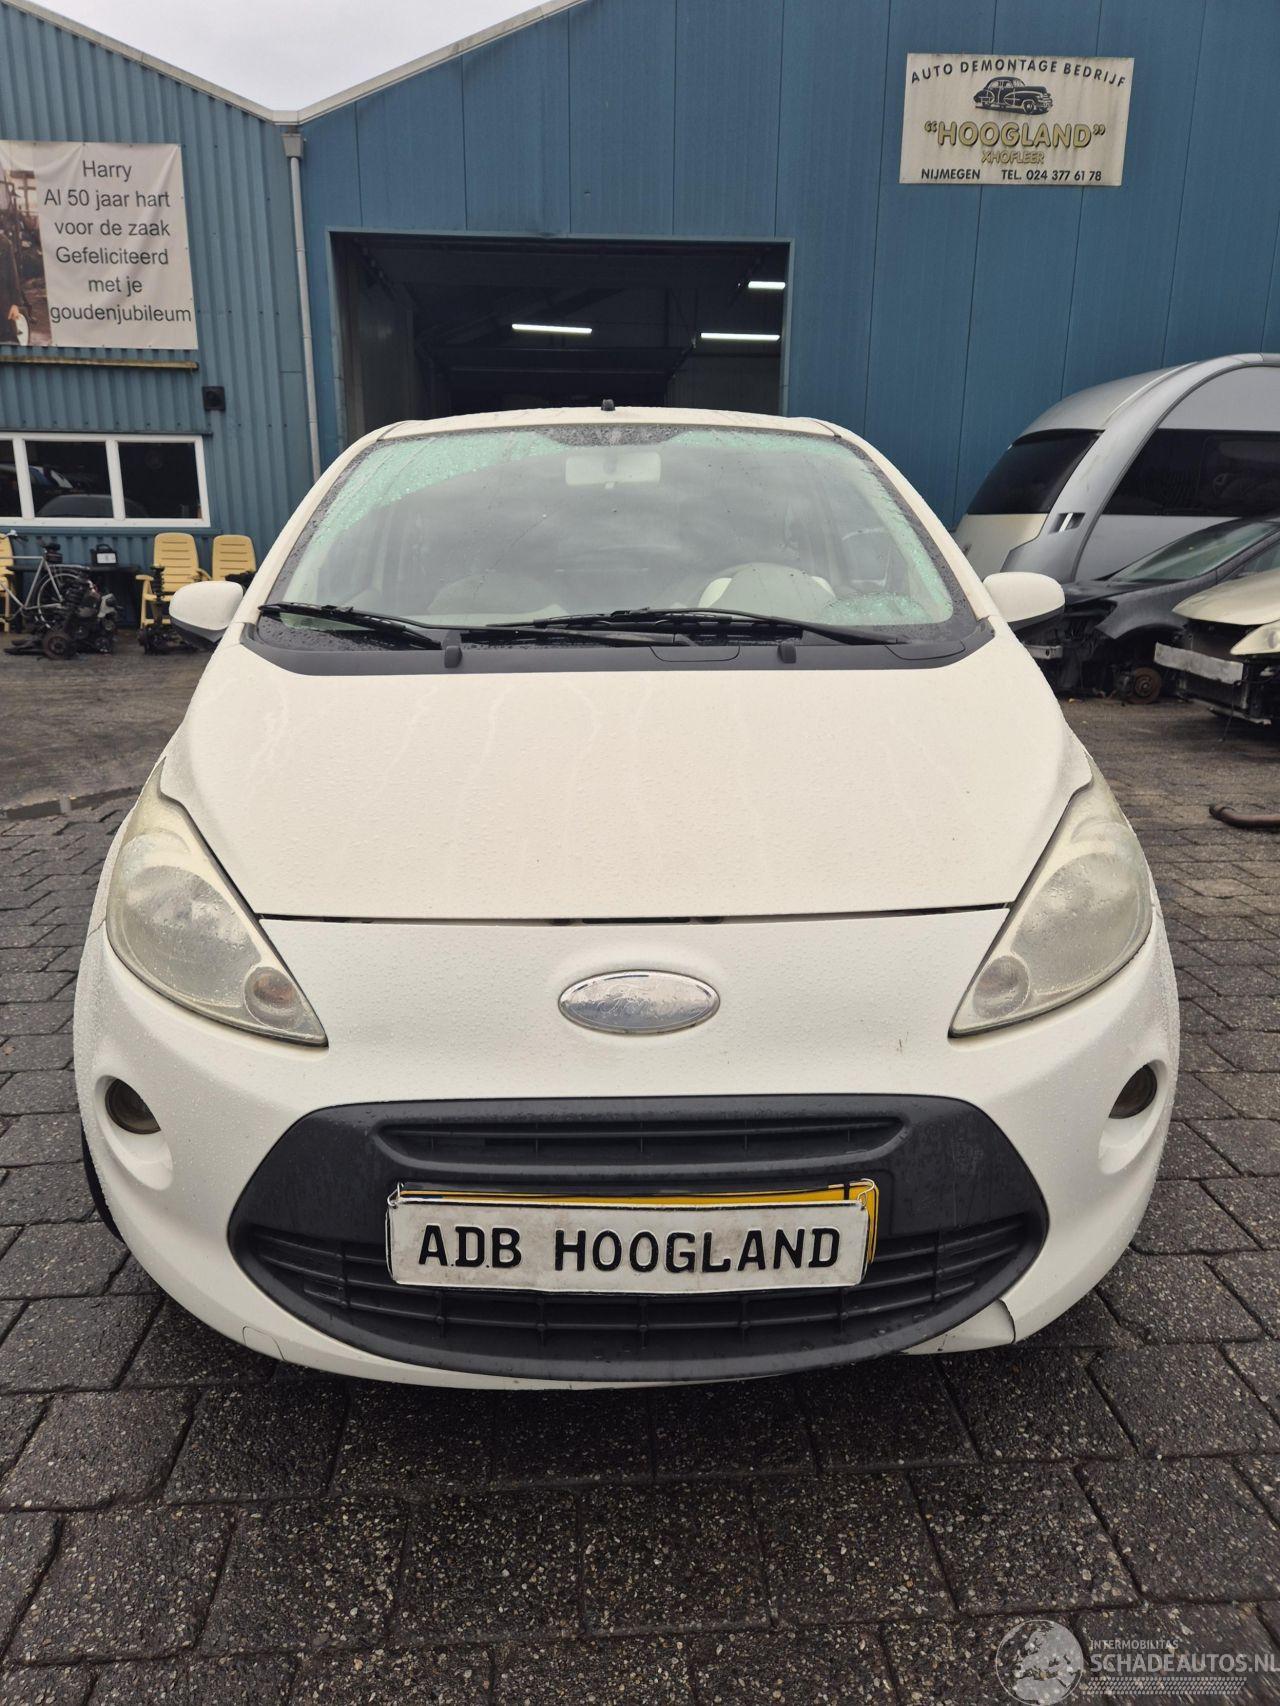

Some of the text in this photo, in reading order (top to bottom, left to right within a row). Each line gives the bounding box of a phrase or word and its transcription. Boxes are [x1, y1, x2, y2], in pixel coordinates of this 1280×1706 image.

[911, 58, 1126, 87] AUTO DEMONTAGE BEDRIJF
[82, 160, 132, 182] Harry
[921, 168, 1102, 182] NIJMEGEN TEL. 024 377 61 78
[44, 189, 171, 210] Al 50 jaar hart
[54, 219, 171, 236] voor de zaak
[55, 246, 169, 265] Gefeliciteerd
[88, 276, 143, 297] met je
[50, 304, 192, 325] goudenjubileum
[554, 1226, 841, 1274] HOOGLAND
